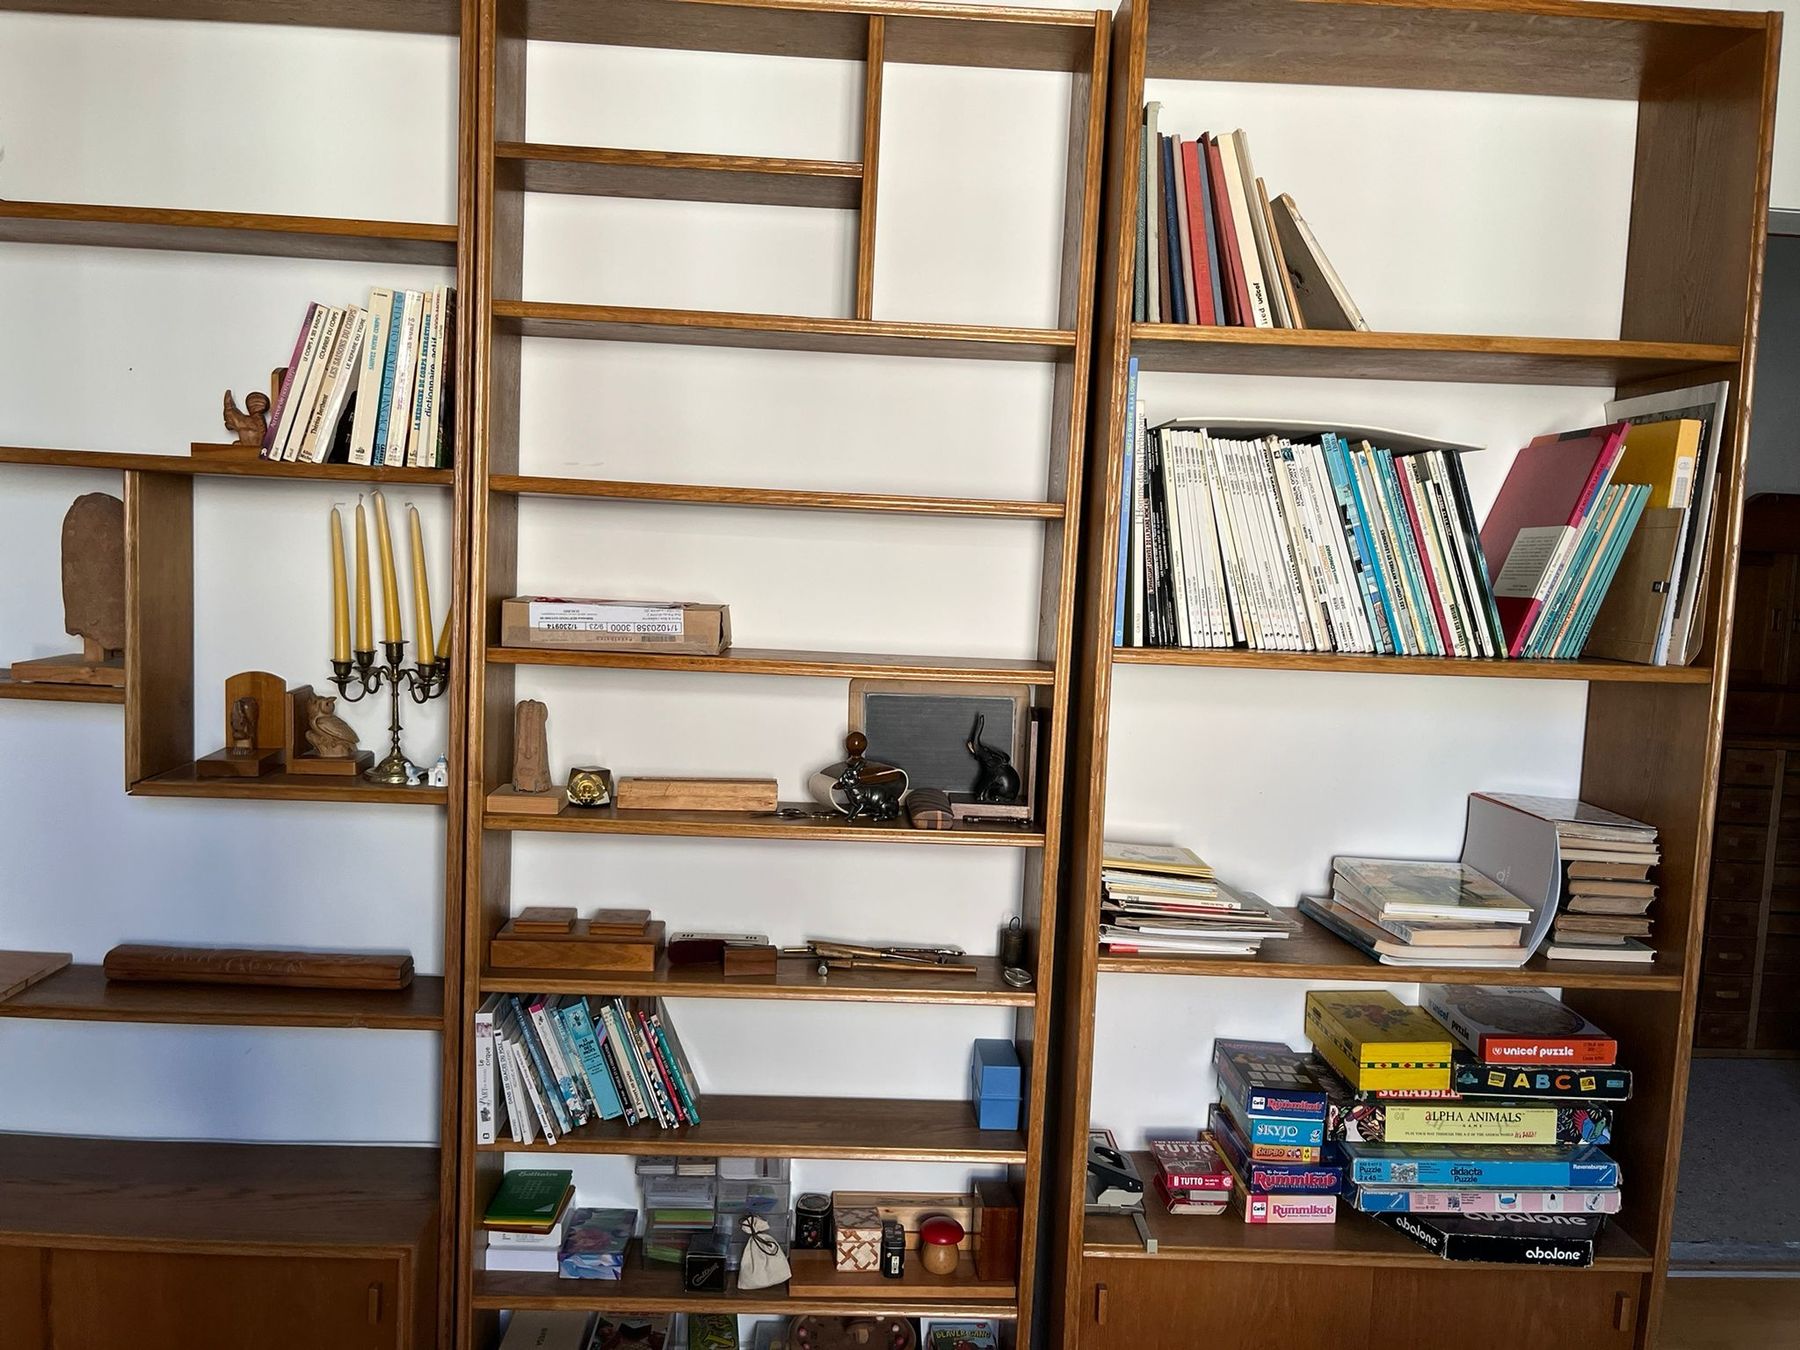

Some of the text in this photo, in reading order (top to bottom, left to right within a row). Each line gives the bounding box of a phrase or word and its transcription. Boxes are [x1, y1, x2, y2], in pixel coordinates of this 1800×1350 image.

[318, 310, 339, 360] COURRIER DU CORPS
[303, 341, 313, 356] CORPS
[328, 307, 357, 378] LES SAISONS DU CORPS
[344, 317, 366, 370] LE REPAIRE DU TIGRE
[418, 357, 428, 378] CORPS
[1134, 412, 1146, 525] L'Homme dans la Préhistoire
[1325, 543, 1336, 572] LONGWAY
[1388, 560, 1397, 580] MYTHES
[1394, 583, 1403, 601] LOUPS
[611, 624, 632, 632] 3000
[636, 624, 678, 633] 1/1020358
[1503, 1046, 1538, 1056] unicef
[1539, 1047, 1574, 1057] puzzle
[501, 1063, 509, 1081] GLACES
[1468, 1111, 1522, 1123] ANIMALS
[1257, 1125, 1298, 1138] SKYJO
[1154, 1144, 1216, 1153] TUTTO
[1359, 1166, 1381, 1174] Puzzle
[1450, 1167, 1482, 1176] didacta
[1181, 1177, 1203, 1185] TUTTO
[1253, 1171, 1337, 1190] Rummikub
[1454, 1175, 1477, 1183] Puzzle
[1273, 1204, 1334, 1218] Rummikub
[1396, 1216, 1438, 1246] abalone
[1526, 1246, 1581, 1260] abalone
[935, 1328, 991, 1339] BEAVER GANG
